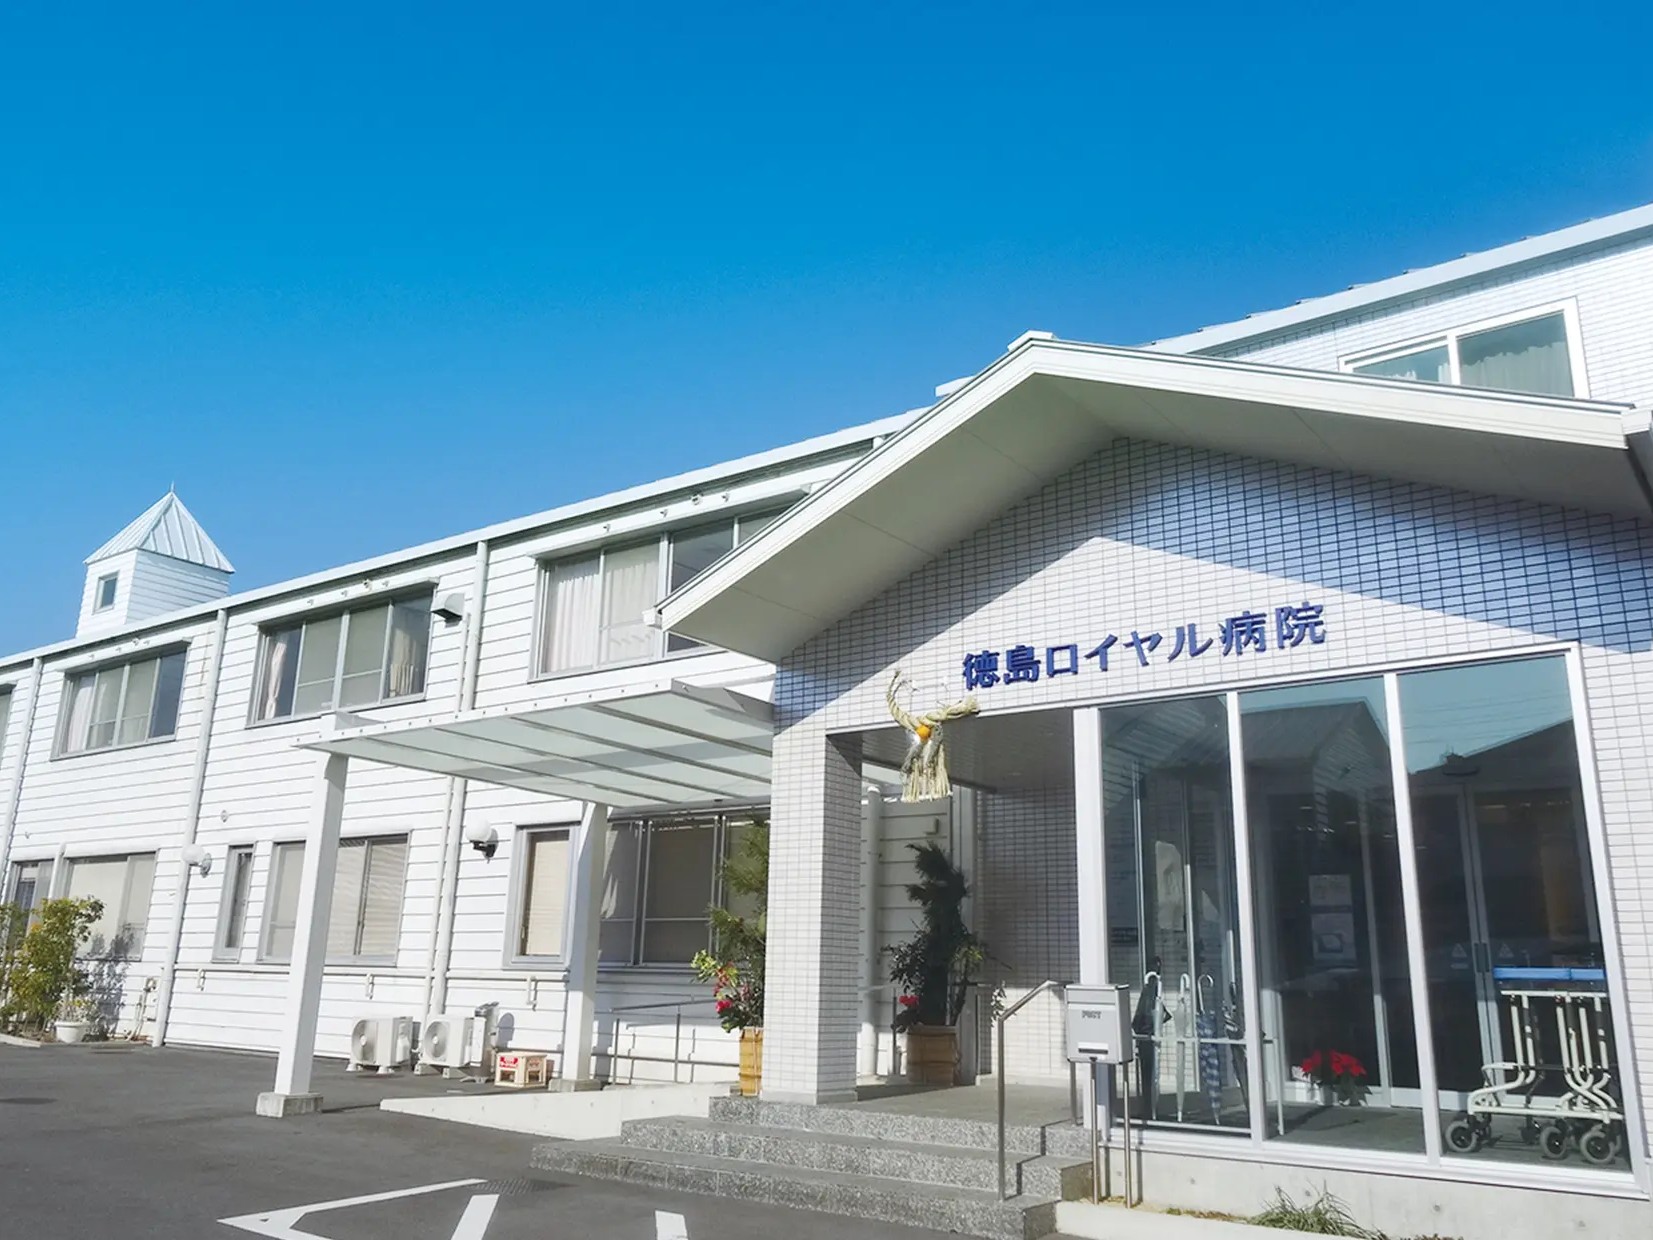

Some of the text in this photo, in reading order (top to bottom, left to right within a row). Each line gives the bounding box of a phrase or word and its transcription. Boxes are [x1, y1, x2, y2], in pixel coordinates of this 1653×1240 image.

[962, 601, 1326, 690] 徳島ロイヤル病院
